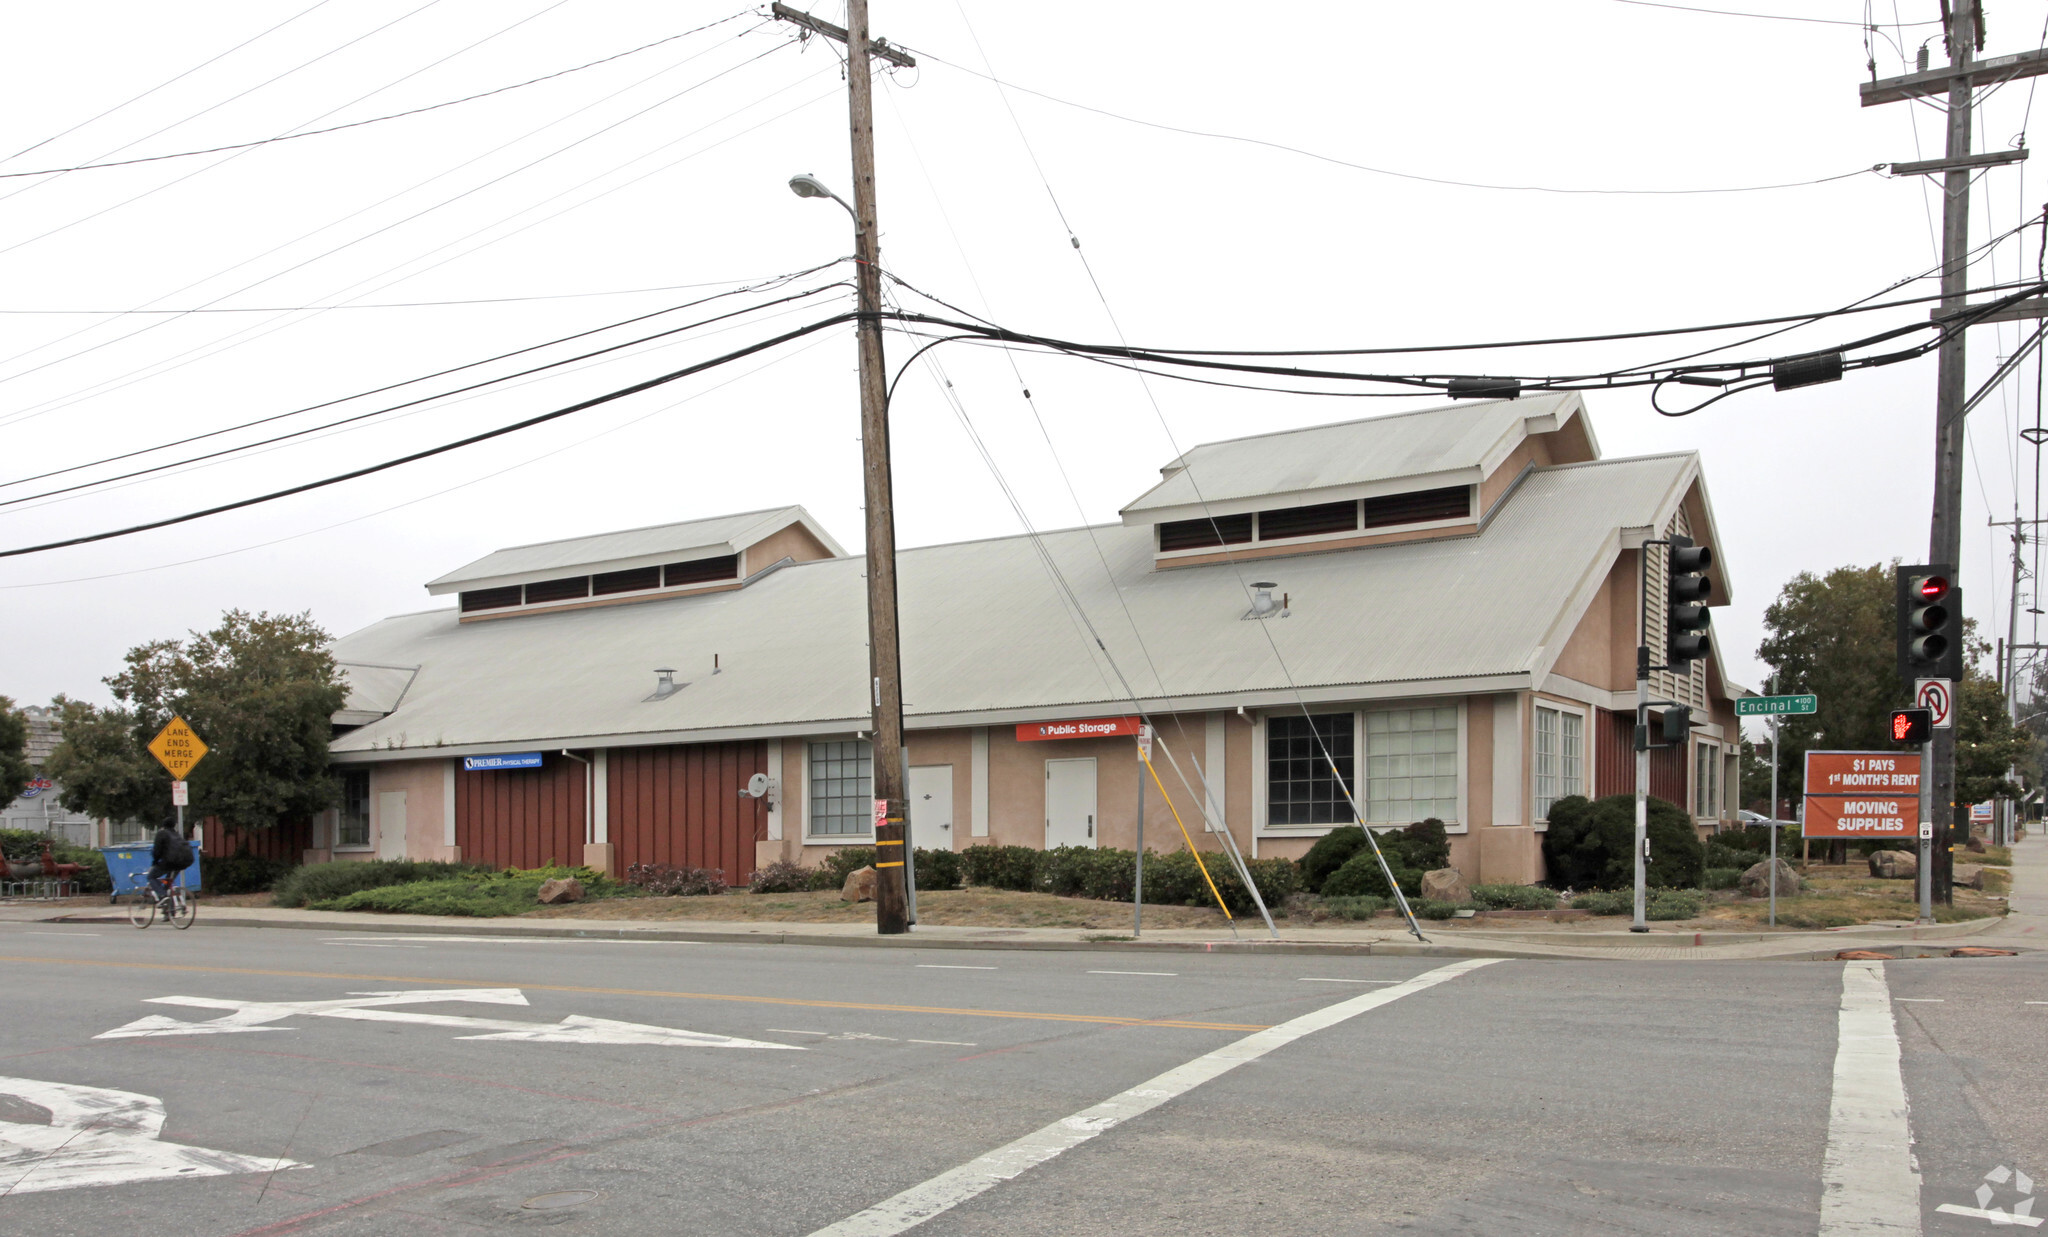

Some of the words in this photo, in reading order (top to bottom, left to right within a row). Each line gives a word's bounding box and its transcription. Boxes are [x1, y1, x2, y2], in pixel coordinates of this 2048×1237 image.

[1740, 700, 1791, 713] Encinal
[167, 728, 189, 737] LANE
[1047, 725, 1077, 735] Public
[1079, 723, 1117, 734] Storage
[167, 738, 190, 748] ENDS
[164, 750, 193, 758] MERGE
[168, 760, 190, 769] LEFT
[474, 758, 502, 768] PREMIER
[1853, 758, 1866, 772] $1
[1868, 759, 1896, 772] PAYS
[1828, 773, 1841, 786] 1st
[1842, 773, 1890, 786] MONTH'S
[1891, 774, 1920, 786] RENT
[1844, 801, 1898, 815] MOVING
[1836, 817, 1904, 831] SUPPLIES
